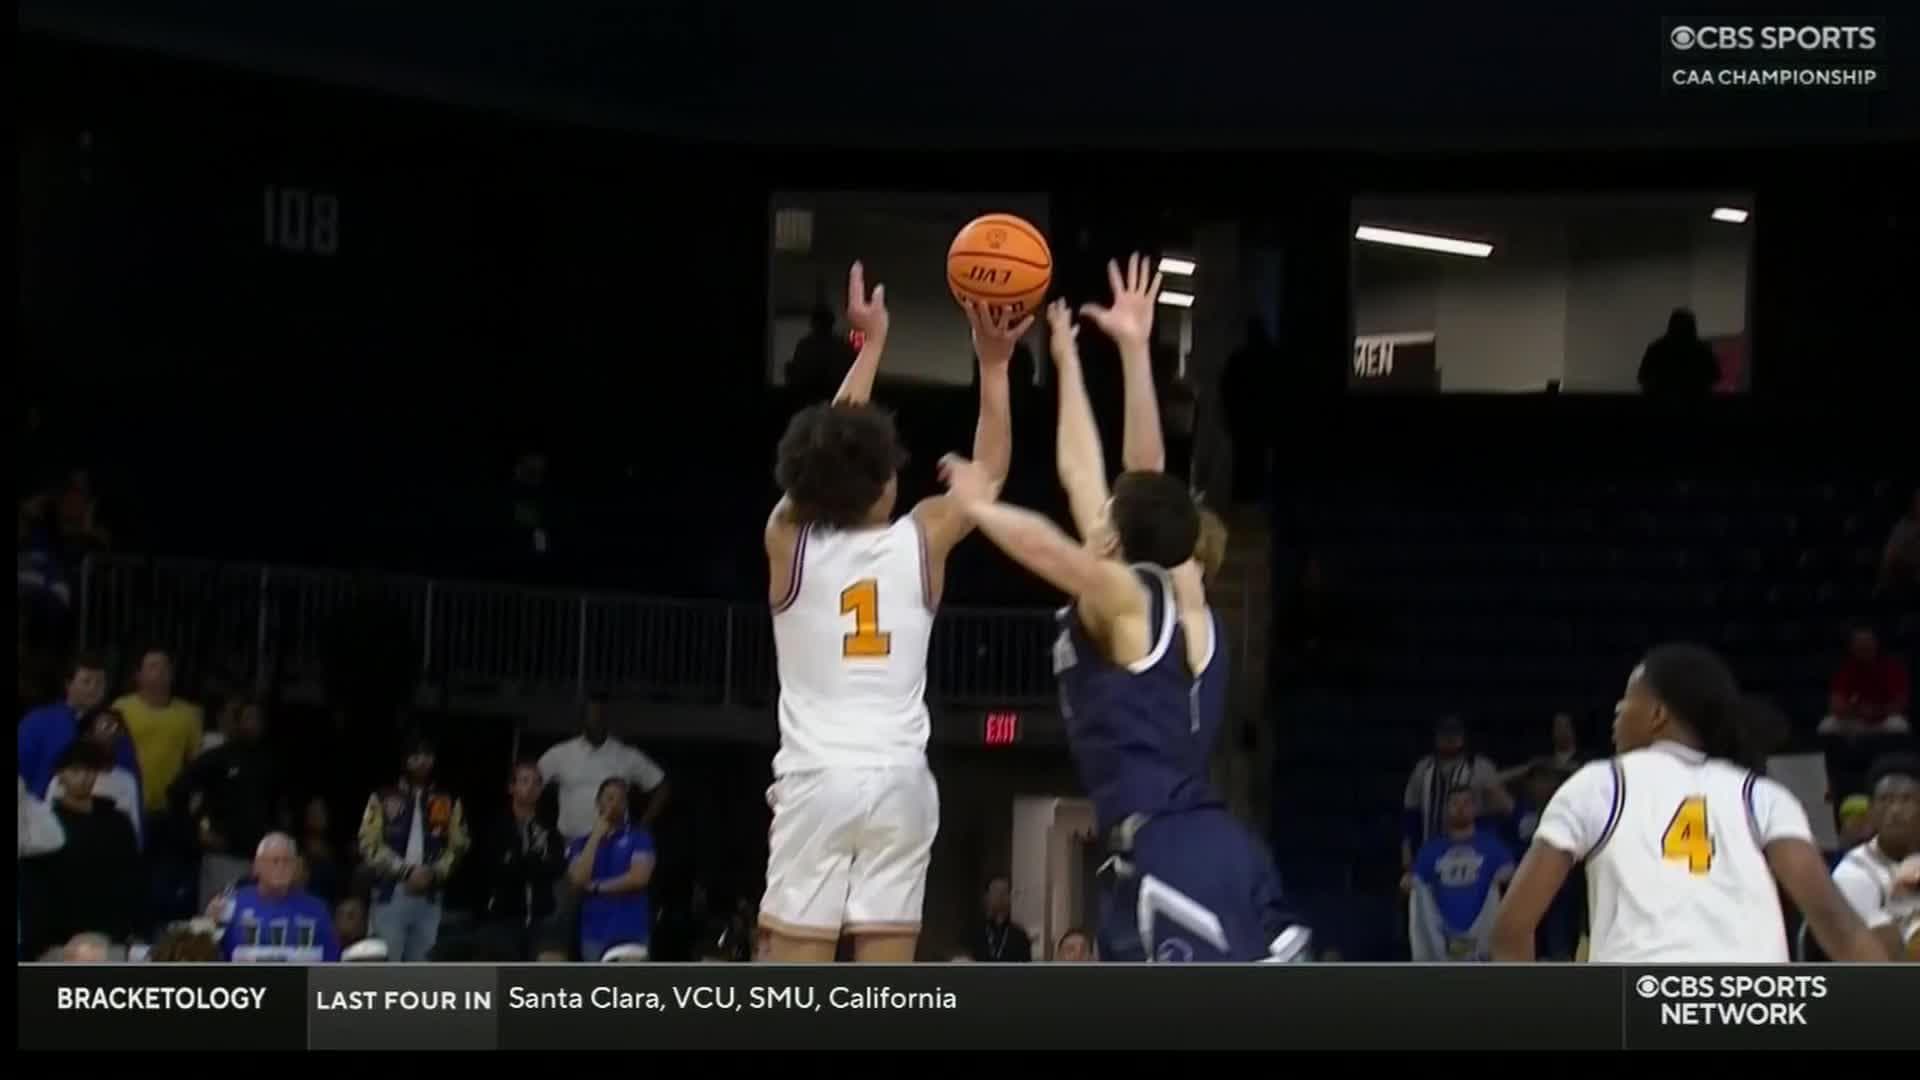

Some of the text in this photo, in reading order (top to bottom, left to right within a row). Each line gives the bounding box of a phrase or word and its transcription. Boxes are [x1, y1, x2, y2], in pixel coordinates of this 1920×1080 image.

[263, 184, 340, 256] 108
[841, 579, 891, 657] 1
[986, 713, 1016, 743] EXIT
[1661, 796, 1714, 873] 4
